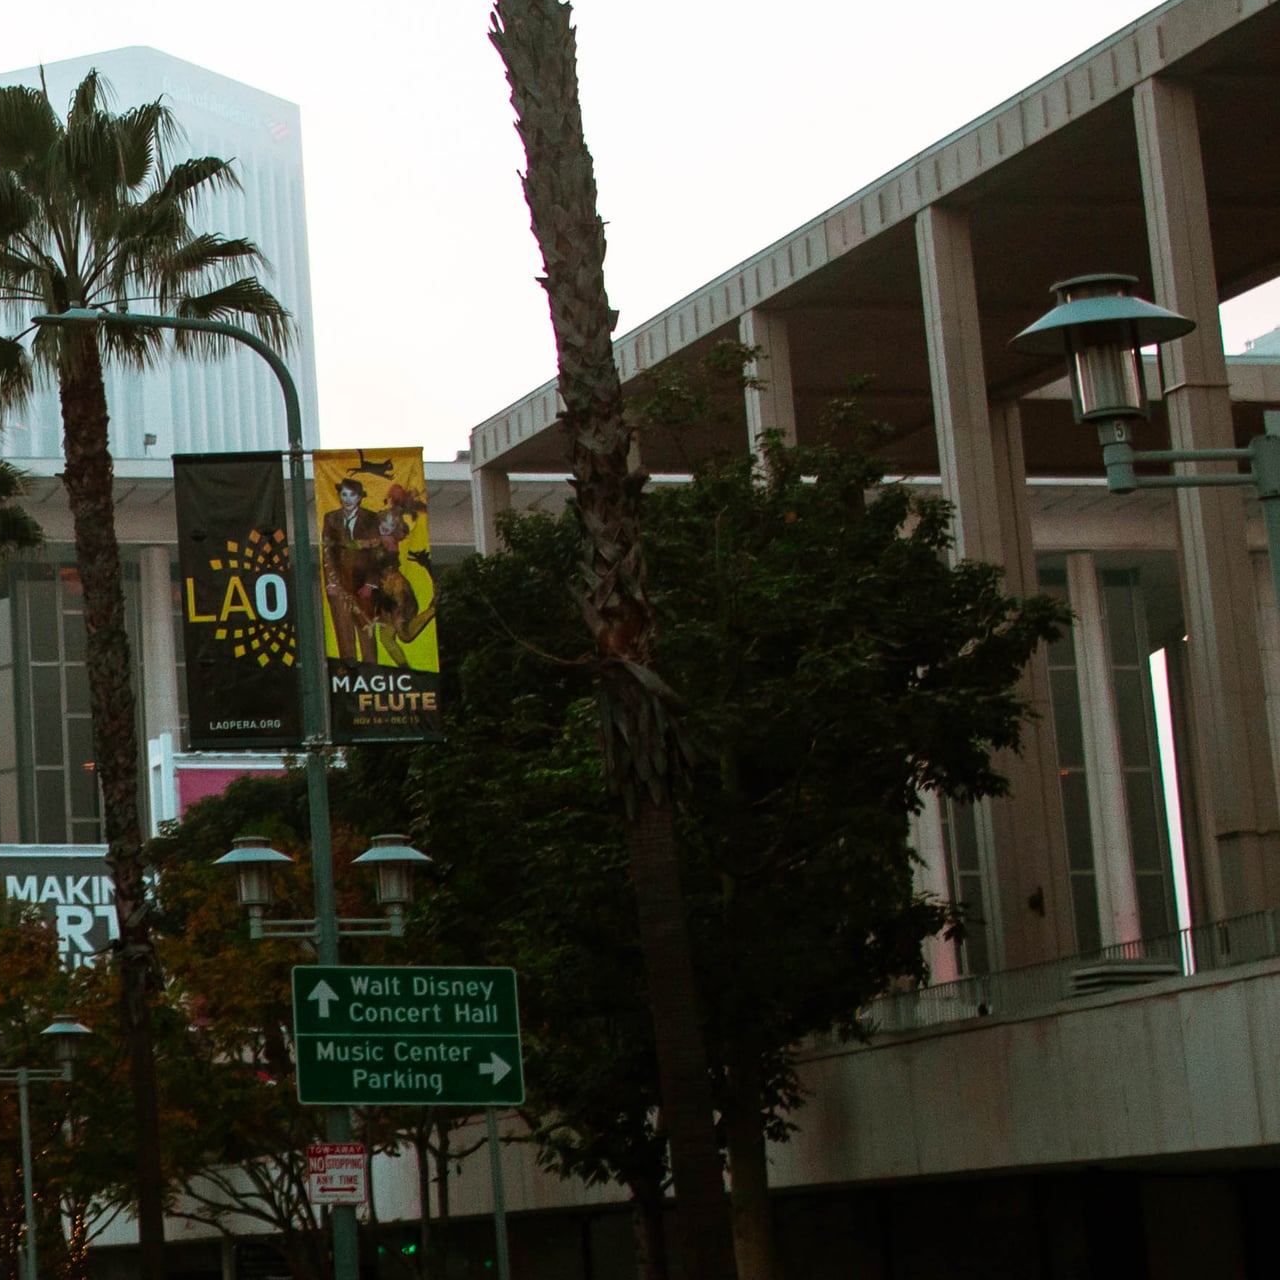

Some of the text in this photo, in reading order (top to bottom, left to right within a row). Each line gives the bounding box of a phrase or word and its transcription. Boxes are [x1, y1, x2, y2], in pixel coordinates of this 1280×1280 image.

[1116, 423, 1124, 438] 5
[186, 573, 288, 623] LAO
[332, 674, 412, 693] MAGIC
[358, 692, 438, 712] FLUTE
[209, 720, 281, 731] LAOPERA.ORG
[38, 905, 121, 954] RT
[350, 975, 494, 1001] Walt Disney
[349, 1003, 498, 1023] Concert Hall
[316, 1040, 473, 1062] Music Center
[353, 1068, 443, 1095] Parking
[310, 1145, 362, 1155] TOW-AWAY
[309, 1157, 325, 1173] NO
[339, 1175, 359, 1185] TIME
